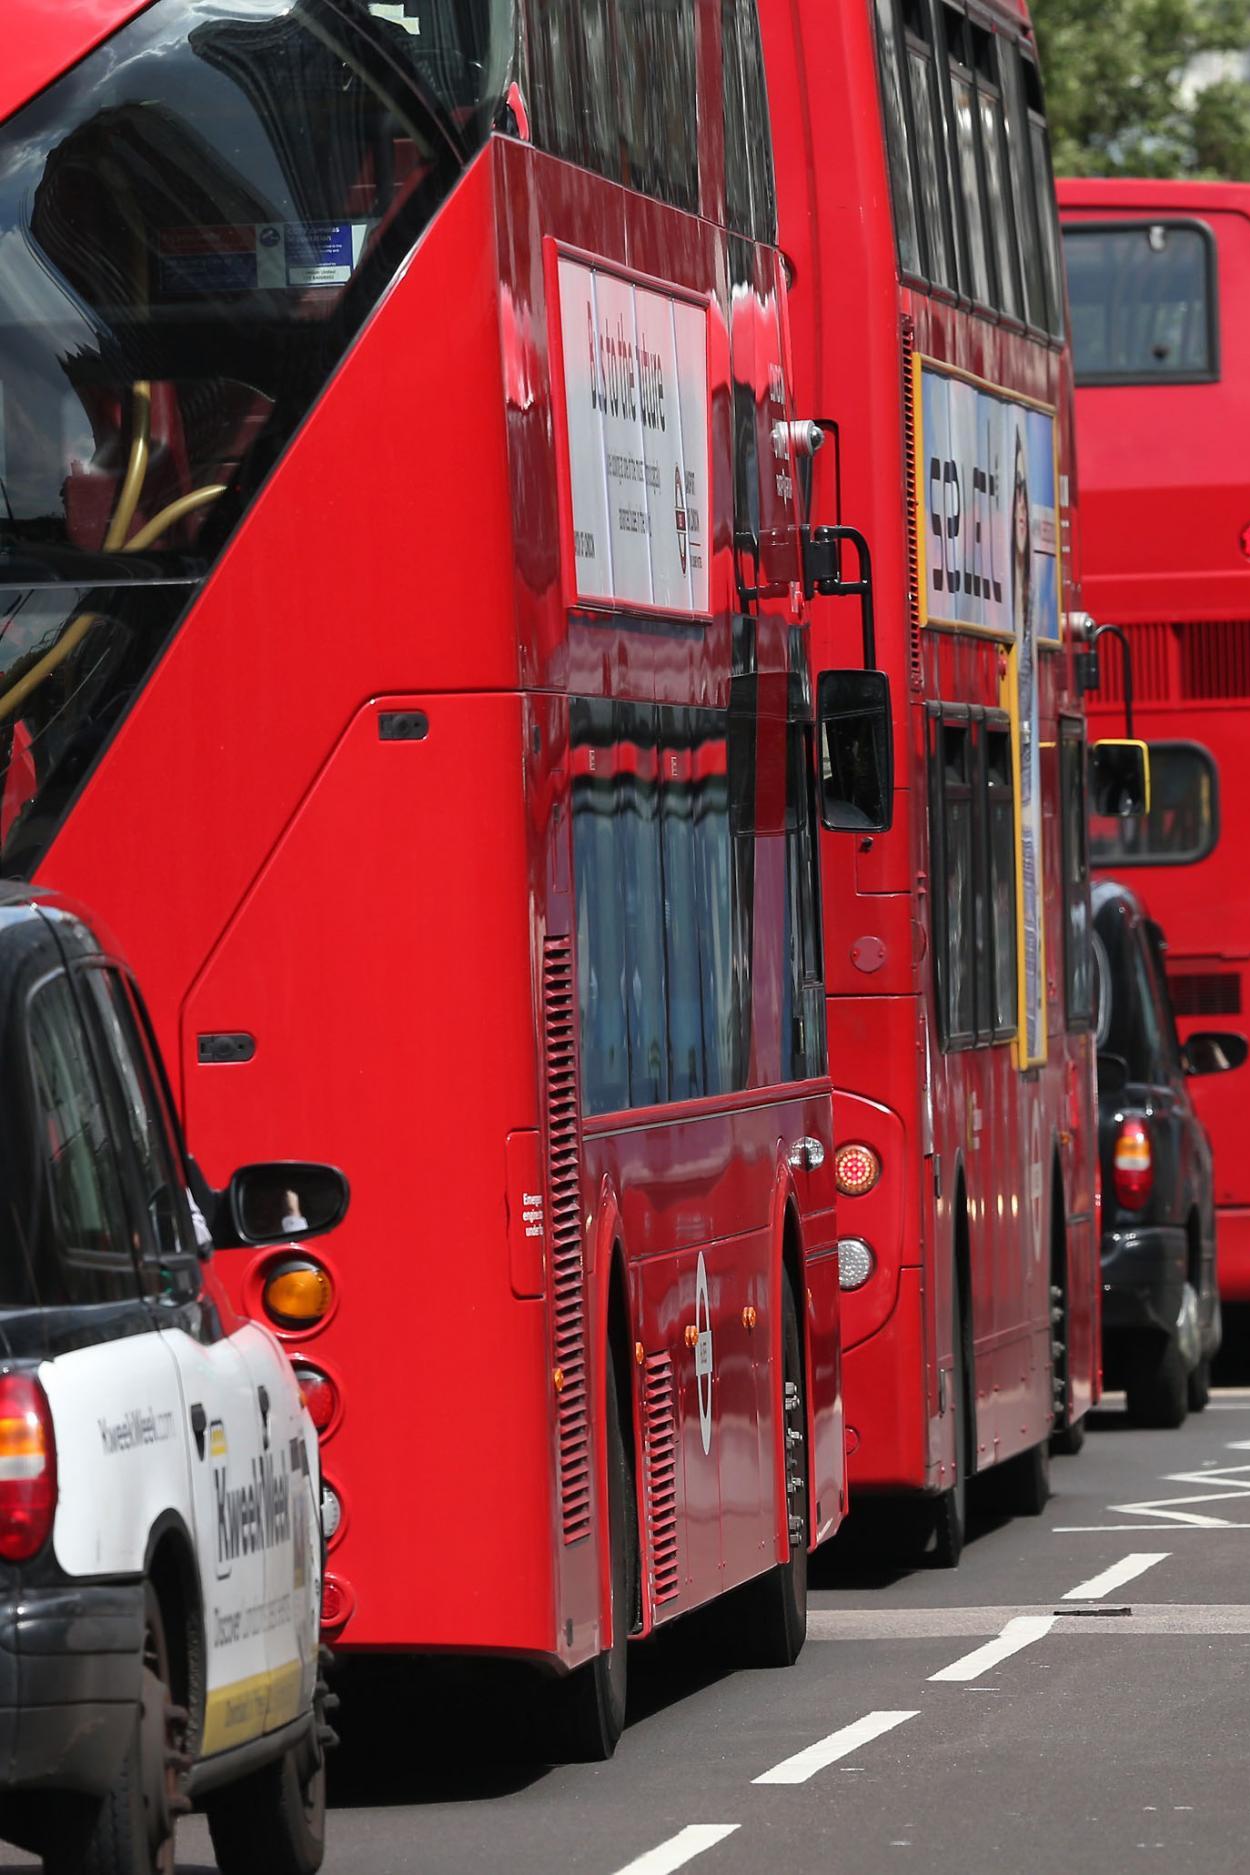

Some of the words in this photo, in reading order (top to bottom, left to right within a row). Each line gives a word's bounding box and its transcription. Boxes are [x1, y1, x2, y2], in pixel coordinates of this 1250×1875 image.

[606, 318, 619, 416] to
[618, 312, 636, 423] the
[214, 1449, 290, 1563] KweekWeek
